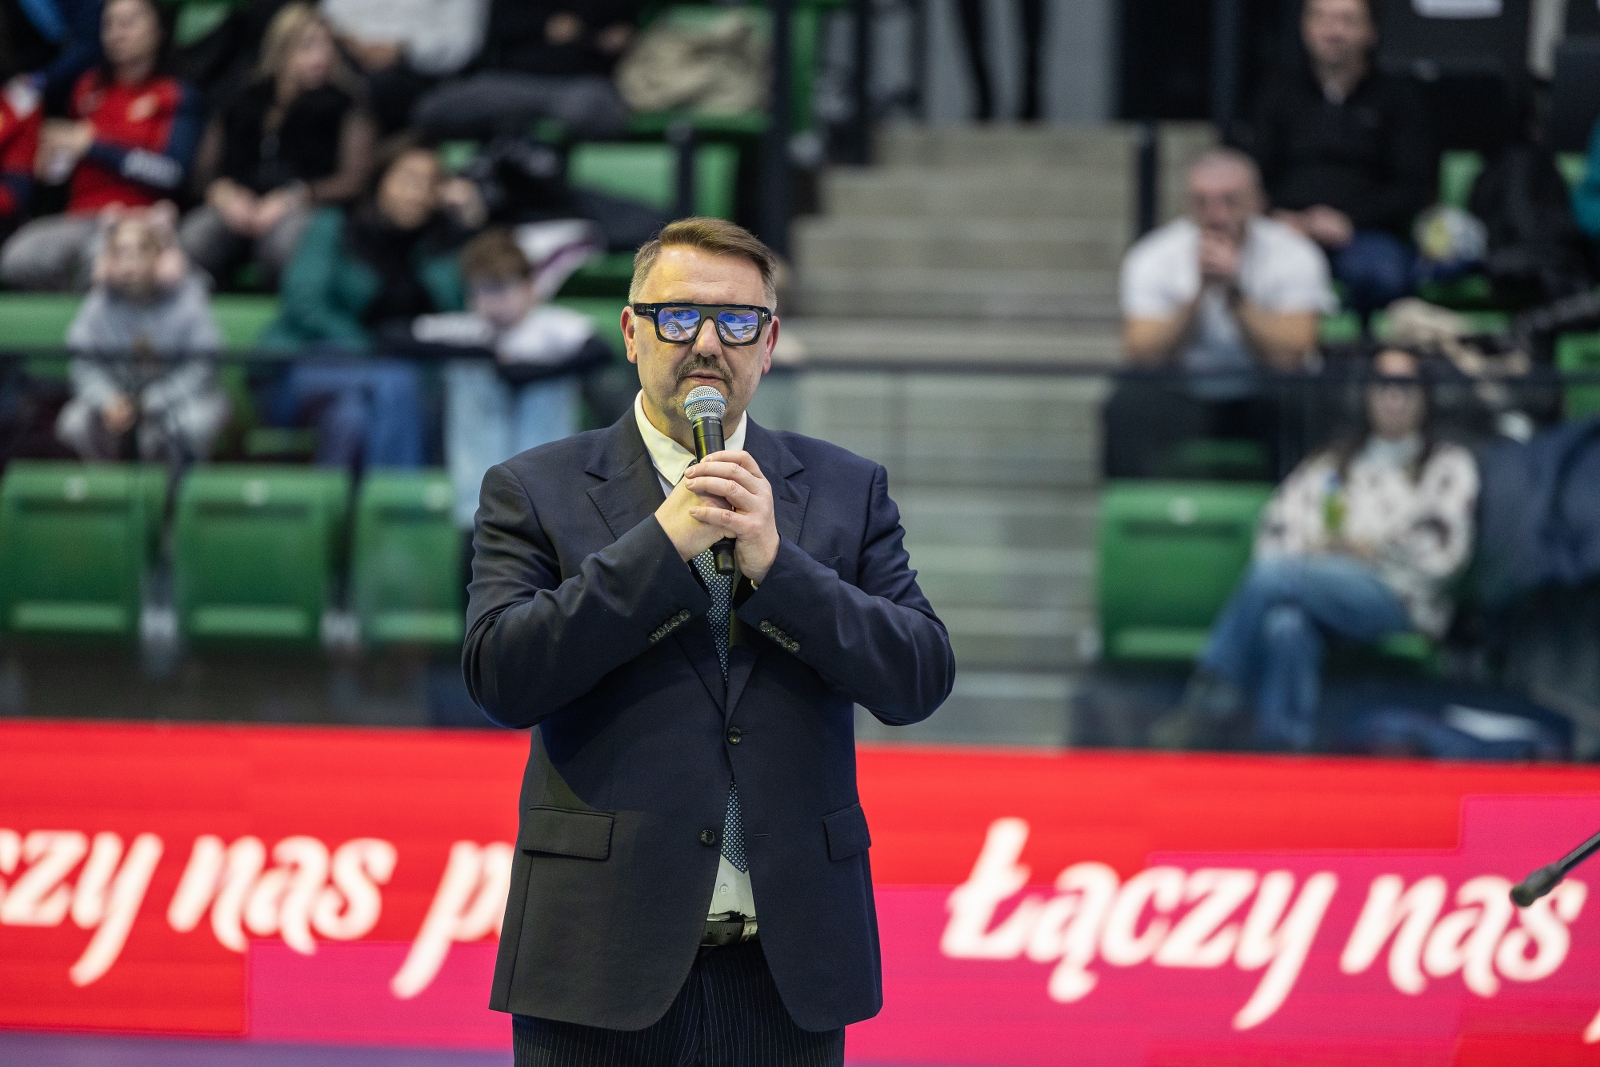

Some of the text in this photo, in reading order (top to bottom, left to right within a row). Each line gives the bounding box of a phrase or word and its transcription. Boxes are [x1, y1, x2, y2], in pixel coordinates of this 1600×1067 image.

[167, 834, 398, 956] nas
[939, 816, 1588, 1031] Łączy nas
